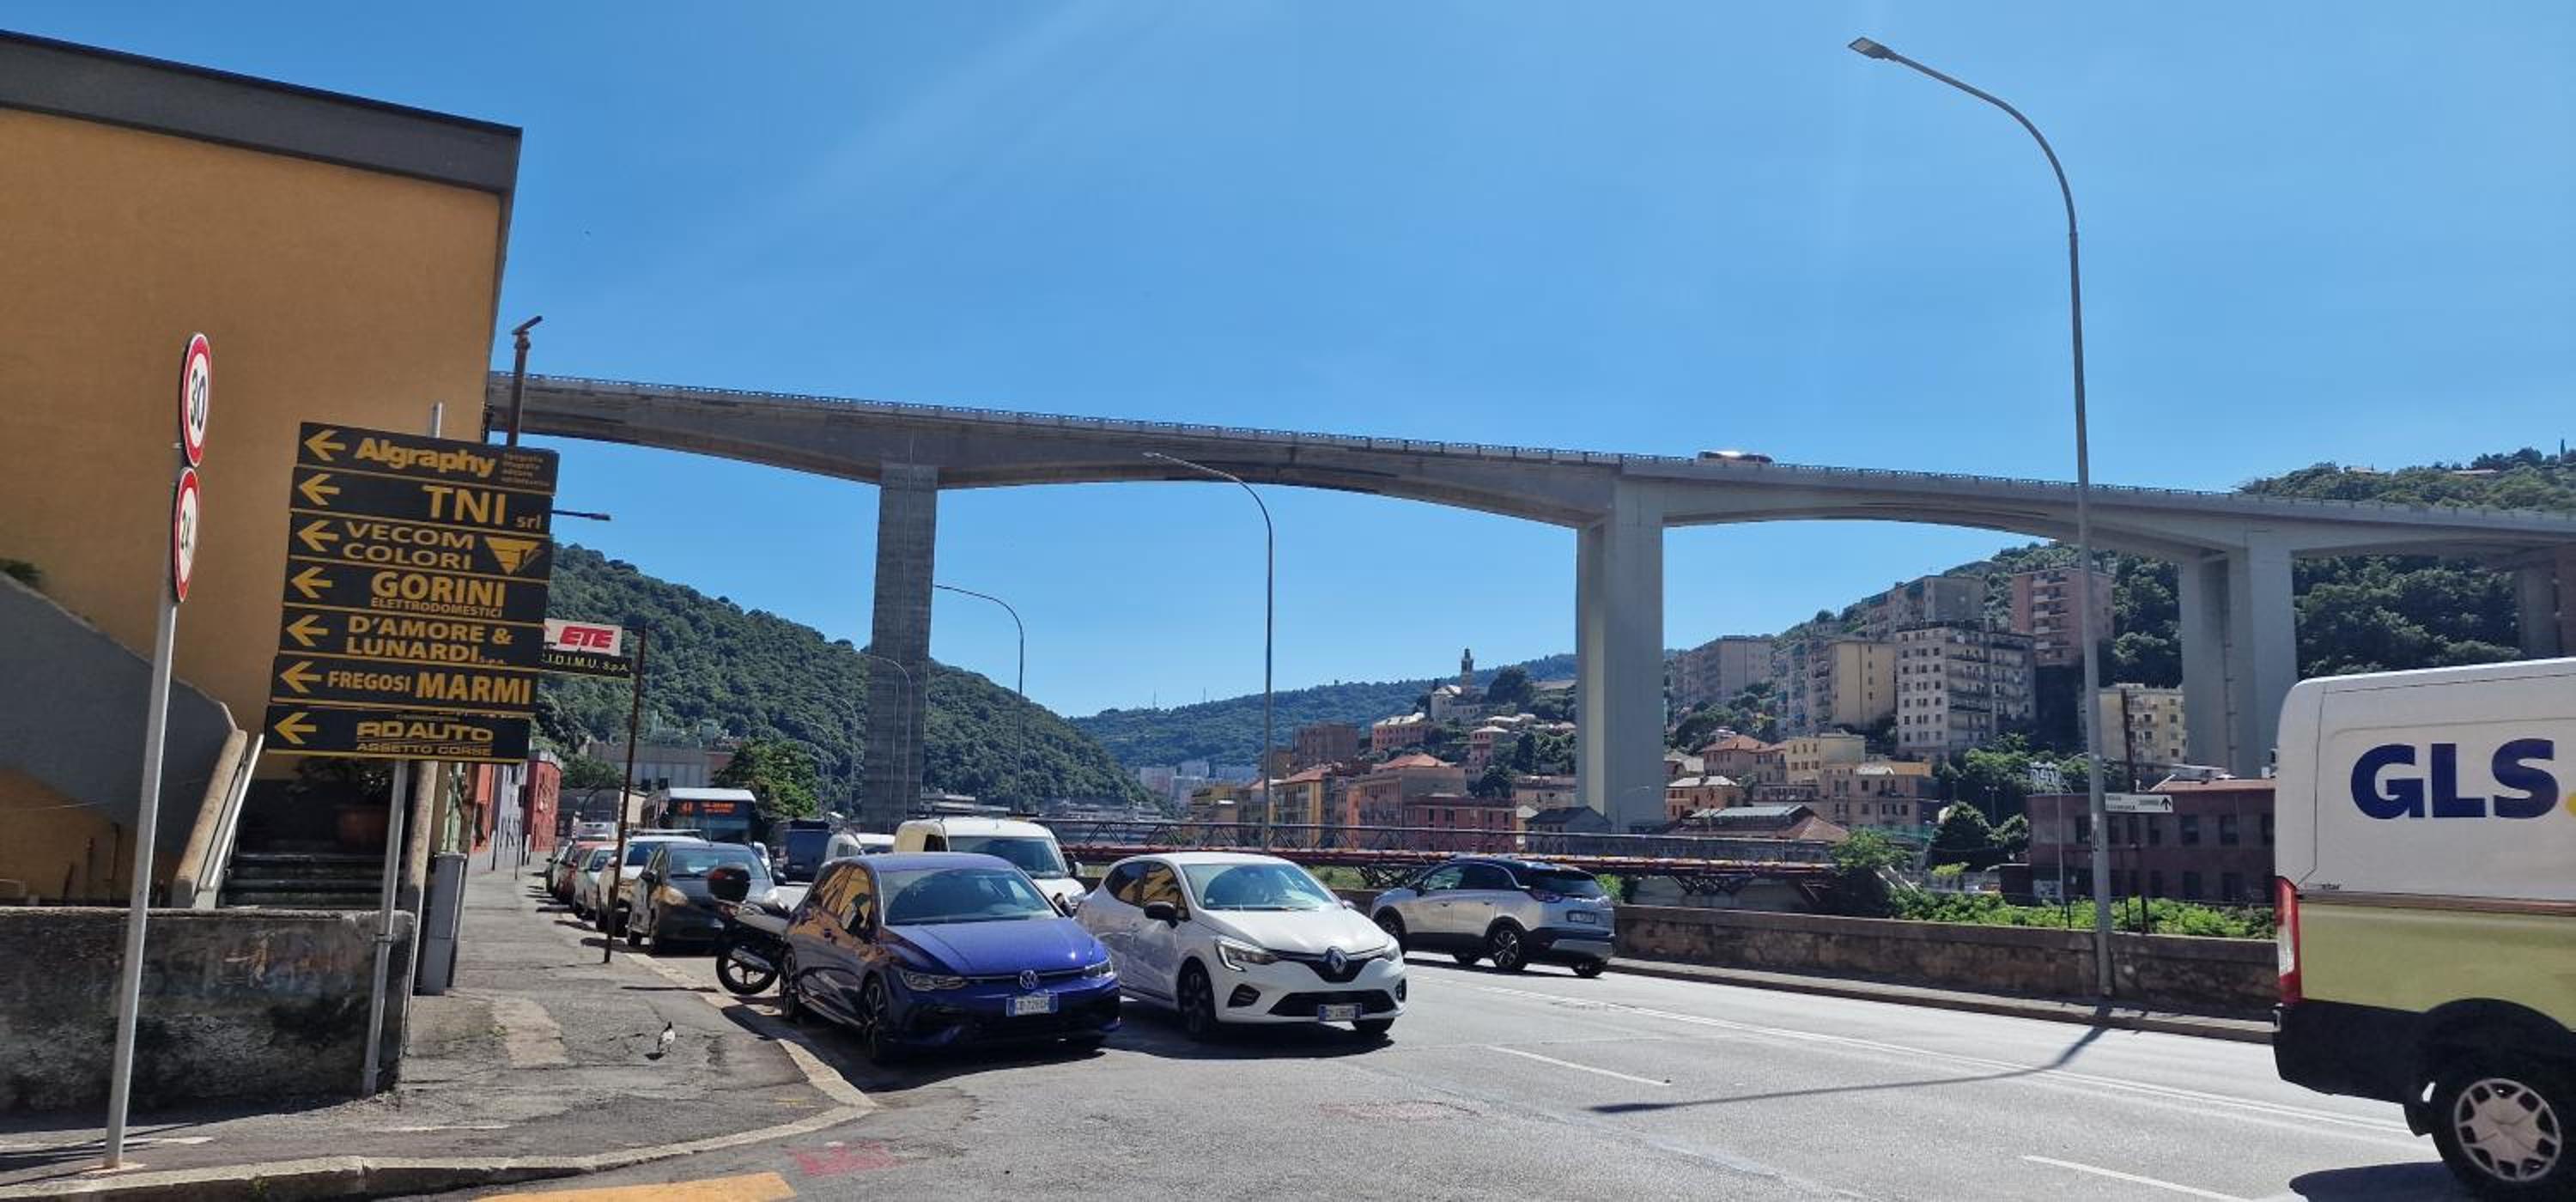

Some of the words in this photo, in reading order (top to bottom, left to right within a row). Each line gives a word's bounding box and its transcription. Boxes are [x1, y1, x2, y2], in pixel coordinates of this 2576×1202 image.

[190, 367, 207, 432] 30
[354, 437, 496, 478] Algraphy
[422, 484, 507, 526] TNI
[516, 513, 542, 530] srl
[345, 520, 474, 550] VECOM
[342, 544, 471, 571] COLORI
[370, 571, 506, 607] GORINI
[370, 598, 502, 618] ELETTRODOMESTICI
[348, 616, 485, 642] D'AMORE
[491, 628, 514, 645] &
[327, 671, 410, 693] FREGOSI
[416, 671, 532, 705] MARMI
[356, 743, 433, 755] ASSETTO
[437, 744, 492, 756] CORSE
[2350, 738, 2560, 820] GLS
